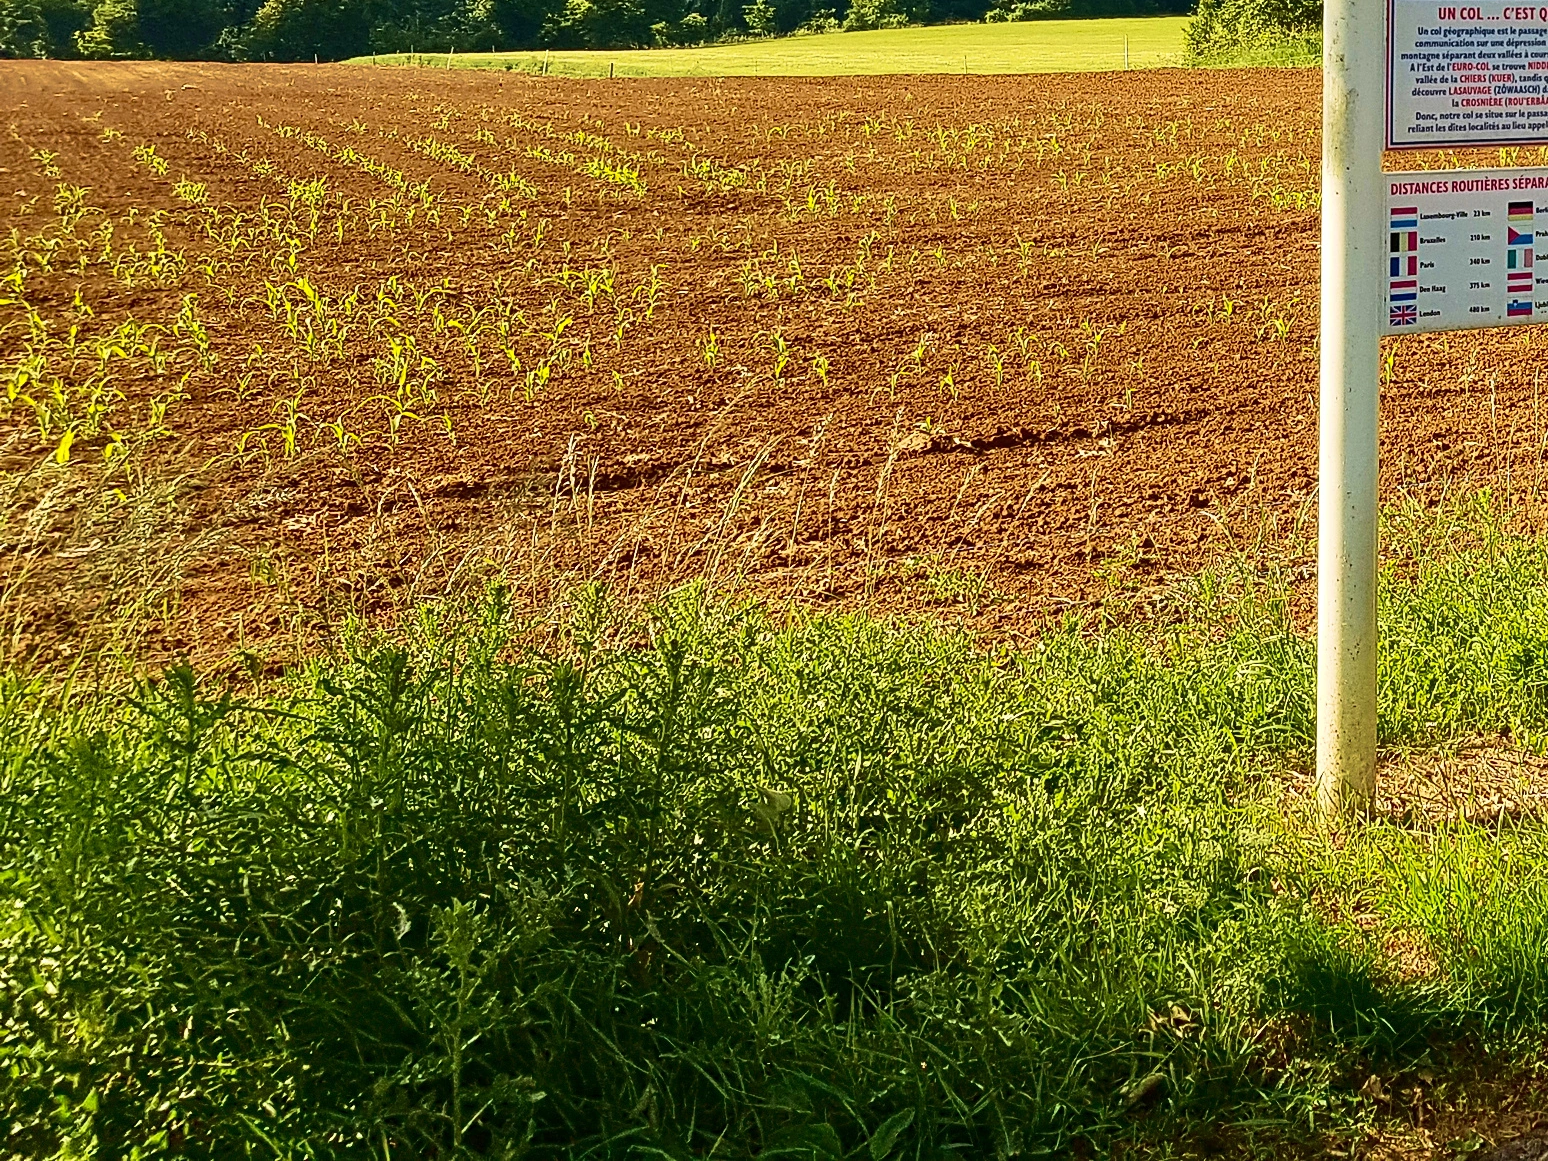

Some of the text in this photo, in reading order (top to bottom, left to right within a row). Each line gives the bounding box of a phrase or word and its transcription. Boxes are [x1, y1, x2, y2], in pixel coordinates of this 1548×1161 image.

[1439, 7, 1455, 20] UN
[1460, 7, 1483, 20] COL
[1504, 7, 1535, 20] C'EST
[1418, 26, 1428, 35] Un
[1430, 26, 1441, 36] col
[1443, 26, 1495, 38] géographique
[1510, 26, 1517, 35] le
[1518, 28, 1547, 38] passage
[1415, 38, 1474, 48] communication
[1506, 37, 1546, 50] dépression
[1401, 52, 1440, 62] montagne
[1442, 50, 1475, 62] séparant
[1478, 50, 1496, 59] deux
[1498, 49, 1522, 59] vallées
[1524, 49, 1528, 58] à
[1410, 63, 1415, 72] A
[1417, 62, 1434, 72] l'Est
[1436, 62, 1445, 71] de
[1447, 62, 1490, 71] l'EURO-COL
[1416, 112, 1437, 121] Donc,
[1440, 112, 1460, 120] notre
[1462, 110, 1473, 119] col
[1485, 109, 1503, 119] situe
[1519, 109, 1525, 117] le
[1391, 181, 1448, 195] DISTANCES
[1452, 176, 1509, 192] ROUTIÈRES
